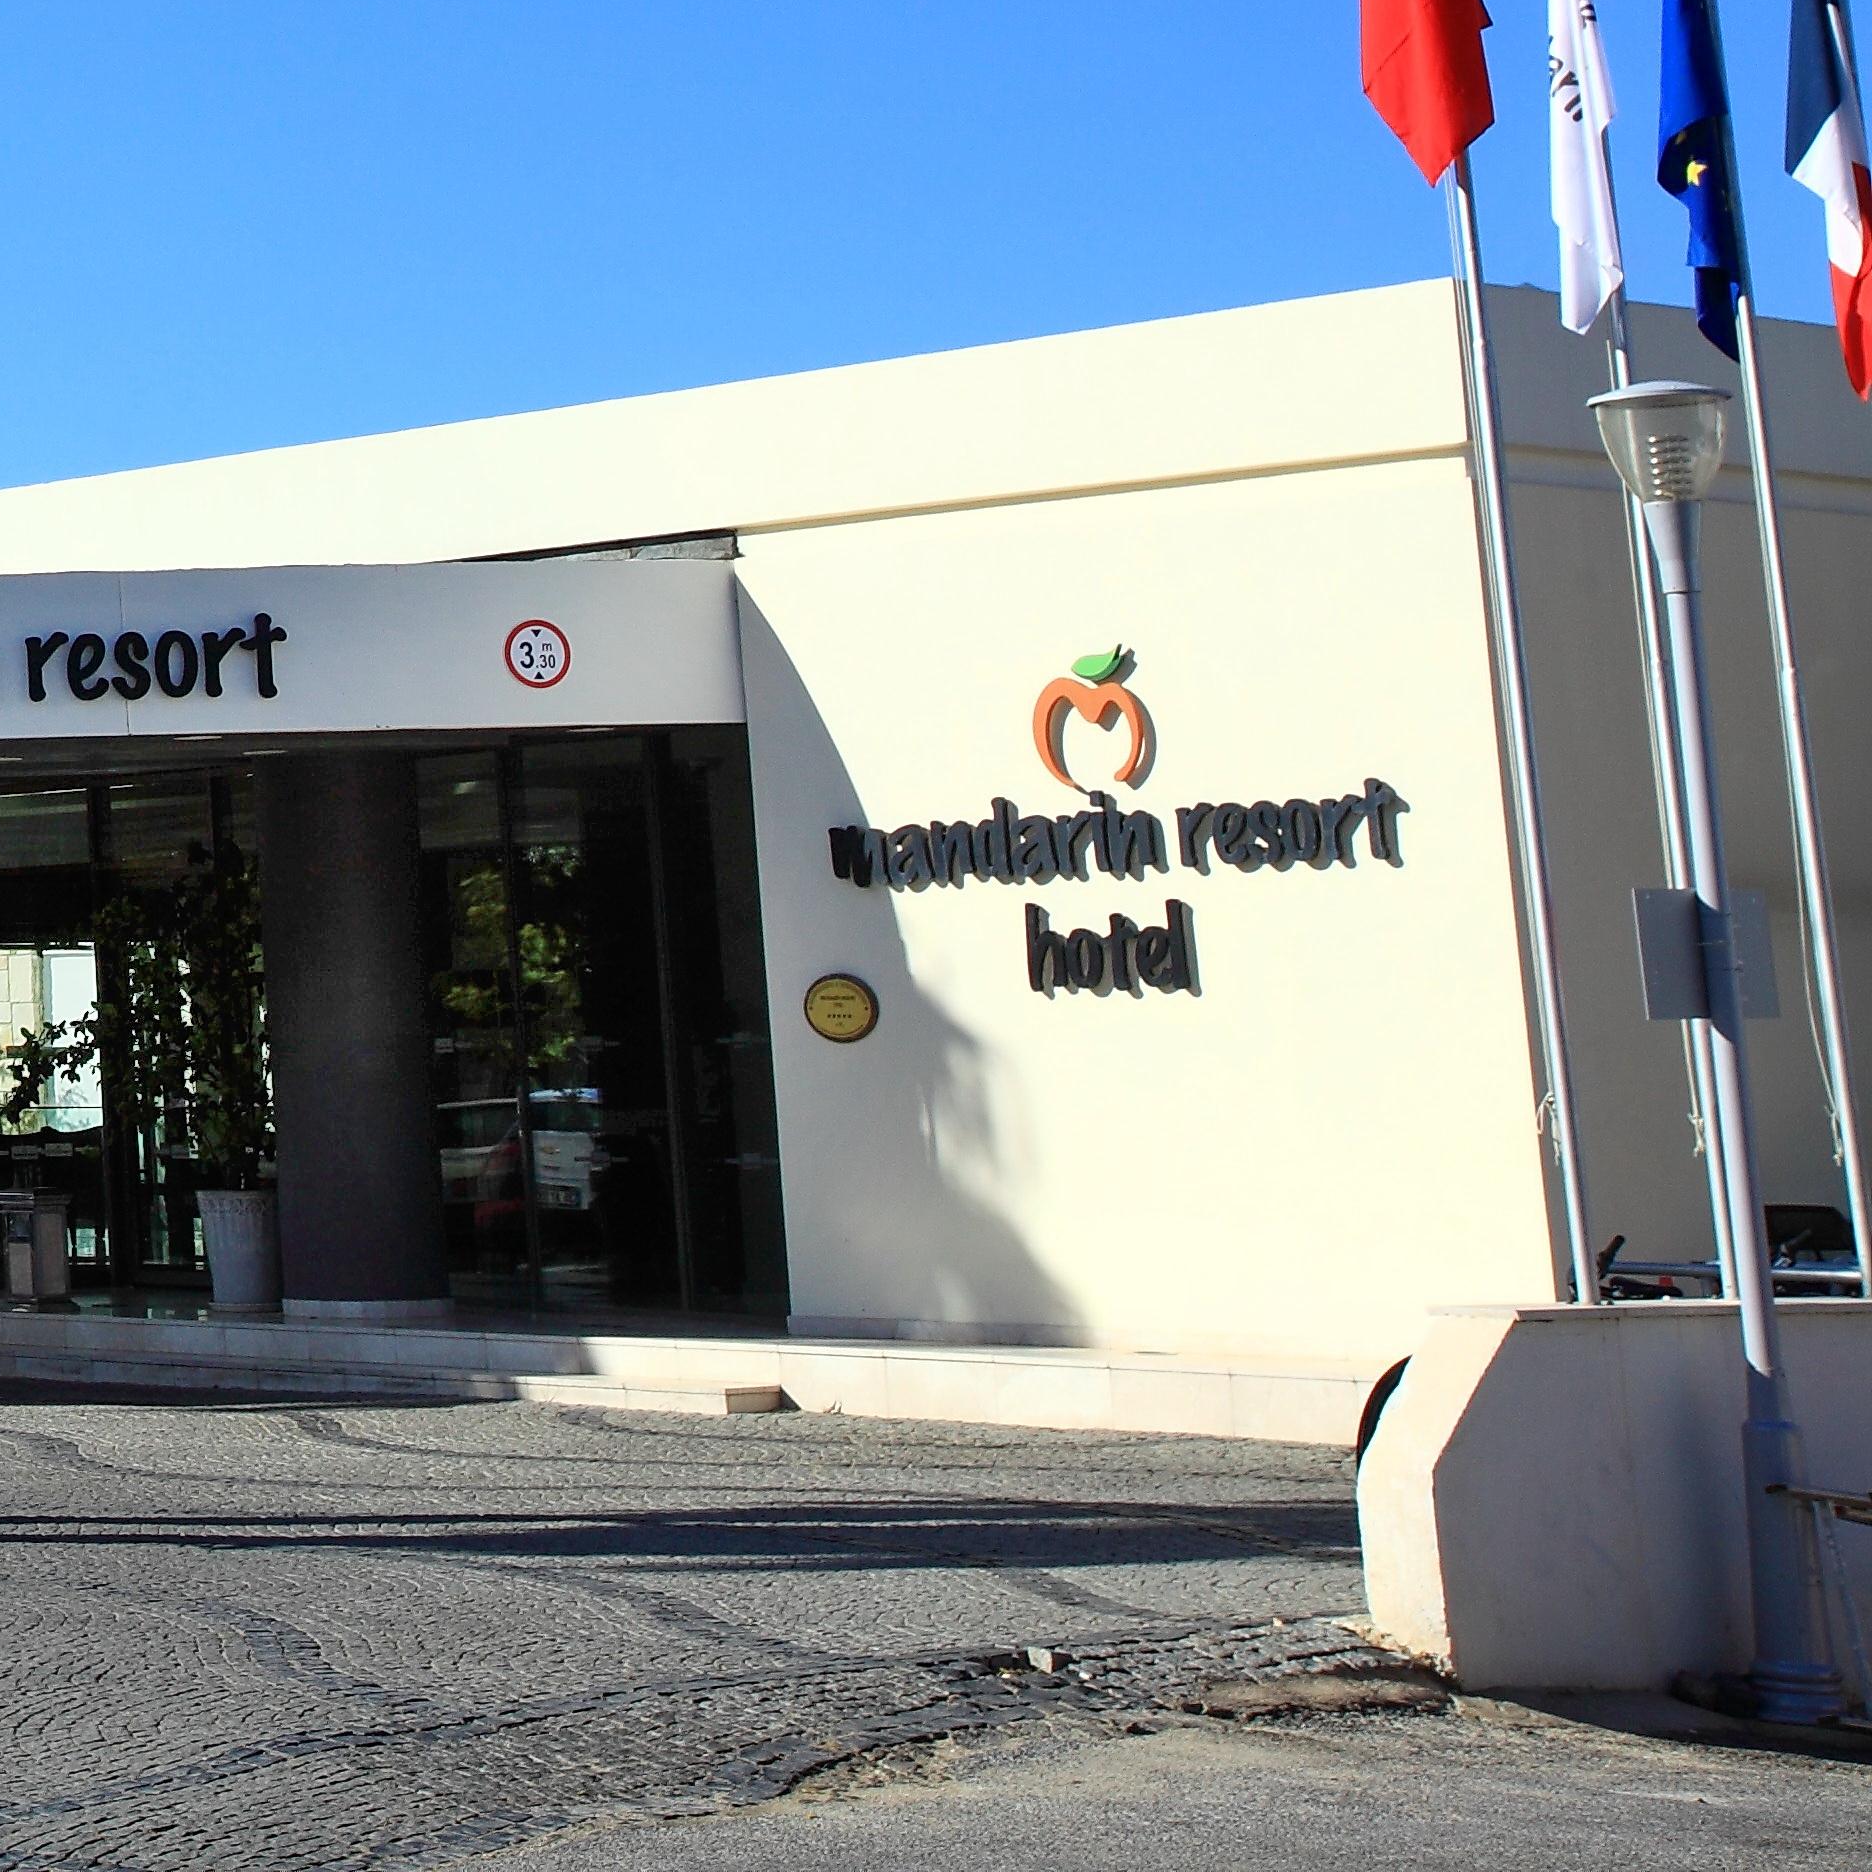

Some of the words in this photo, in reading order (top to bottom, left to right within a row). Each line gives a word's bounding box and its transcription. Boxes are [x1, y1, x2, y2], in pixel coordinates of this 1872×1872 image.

[24, 612, 288, 702] resort
[828, 790, 1165, 889] mandarin
[1175, 777, 1409, 873] resort
[1024, 898, 1198, 998] hotel
